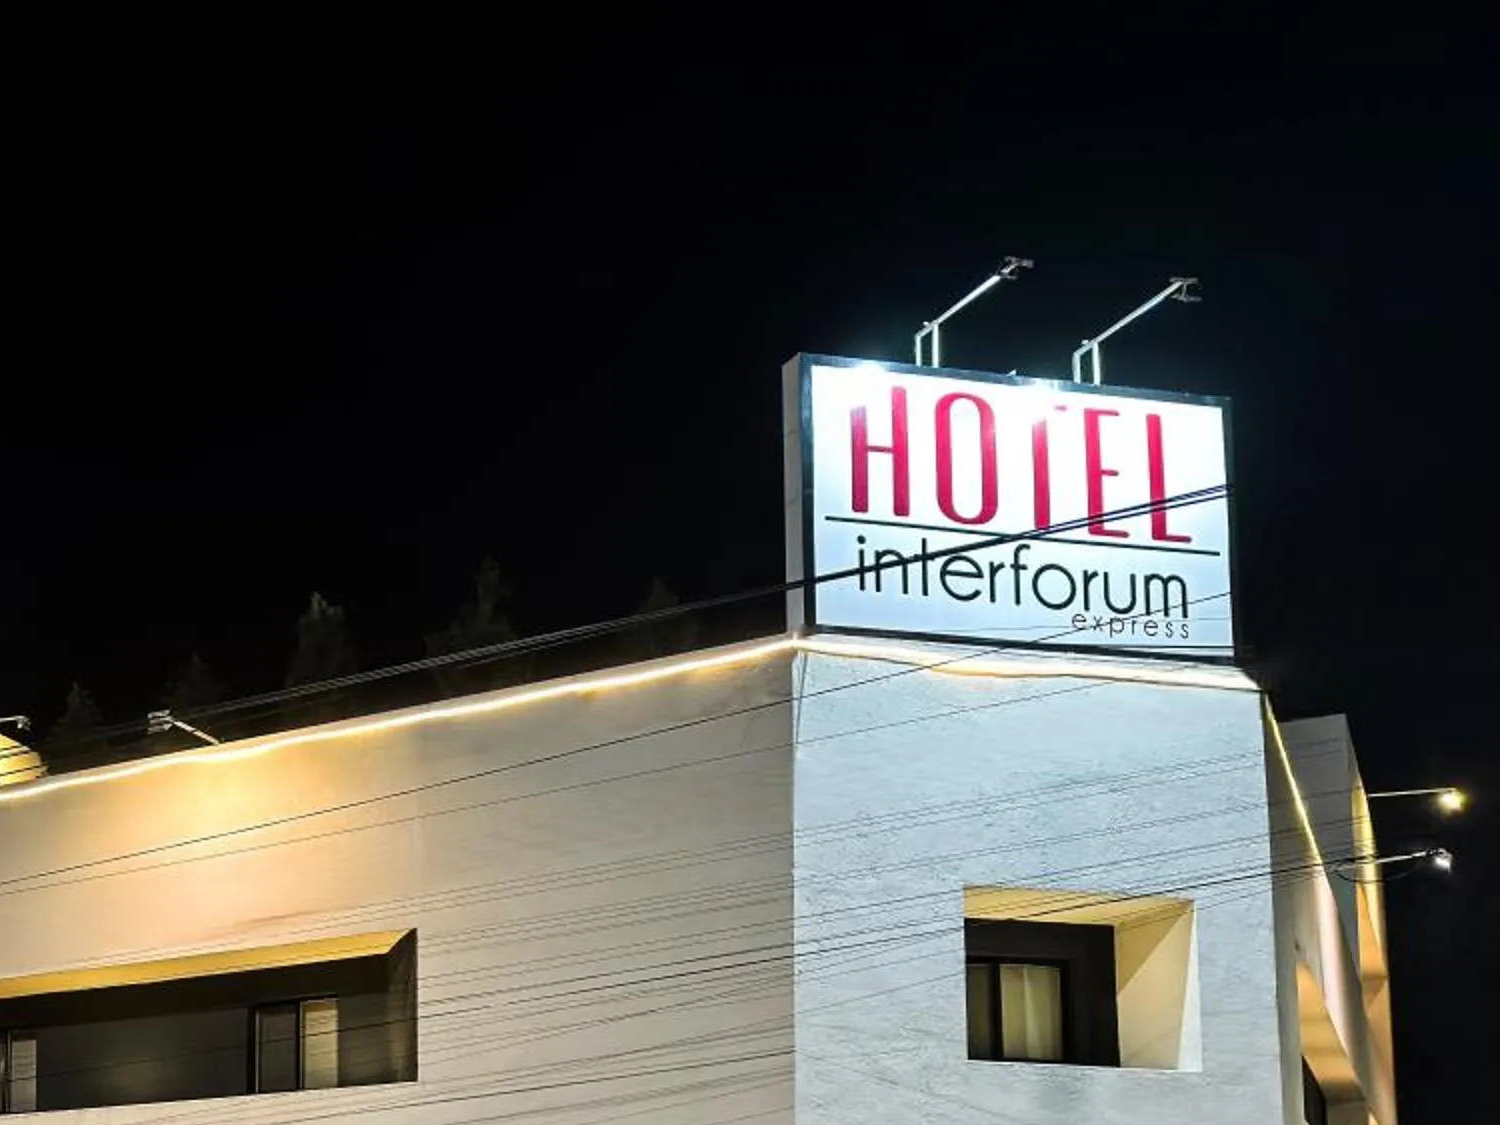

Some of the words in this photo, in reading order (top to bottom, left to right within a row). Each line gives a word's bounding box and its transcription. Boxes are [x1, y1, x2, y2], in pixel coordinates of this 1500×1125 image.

[850, 386, 1192, 544] HOTEL
[856, 535, 1190, 619] interforum
[1071, 613, 1190, 640] express
